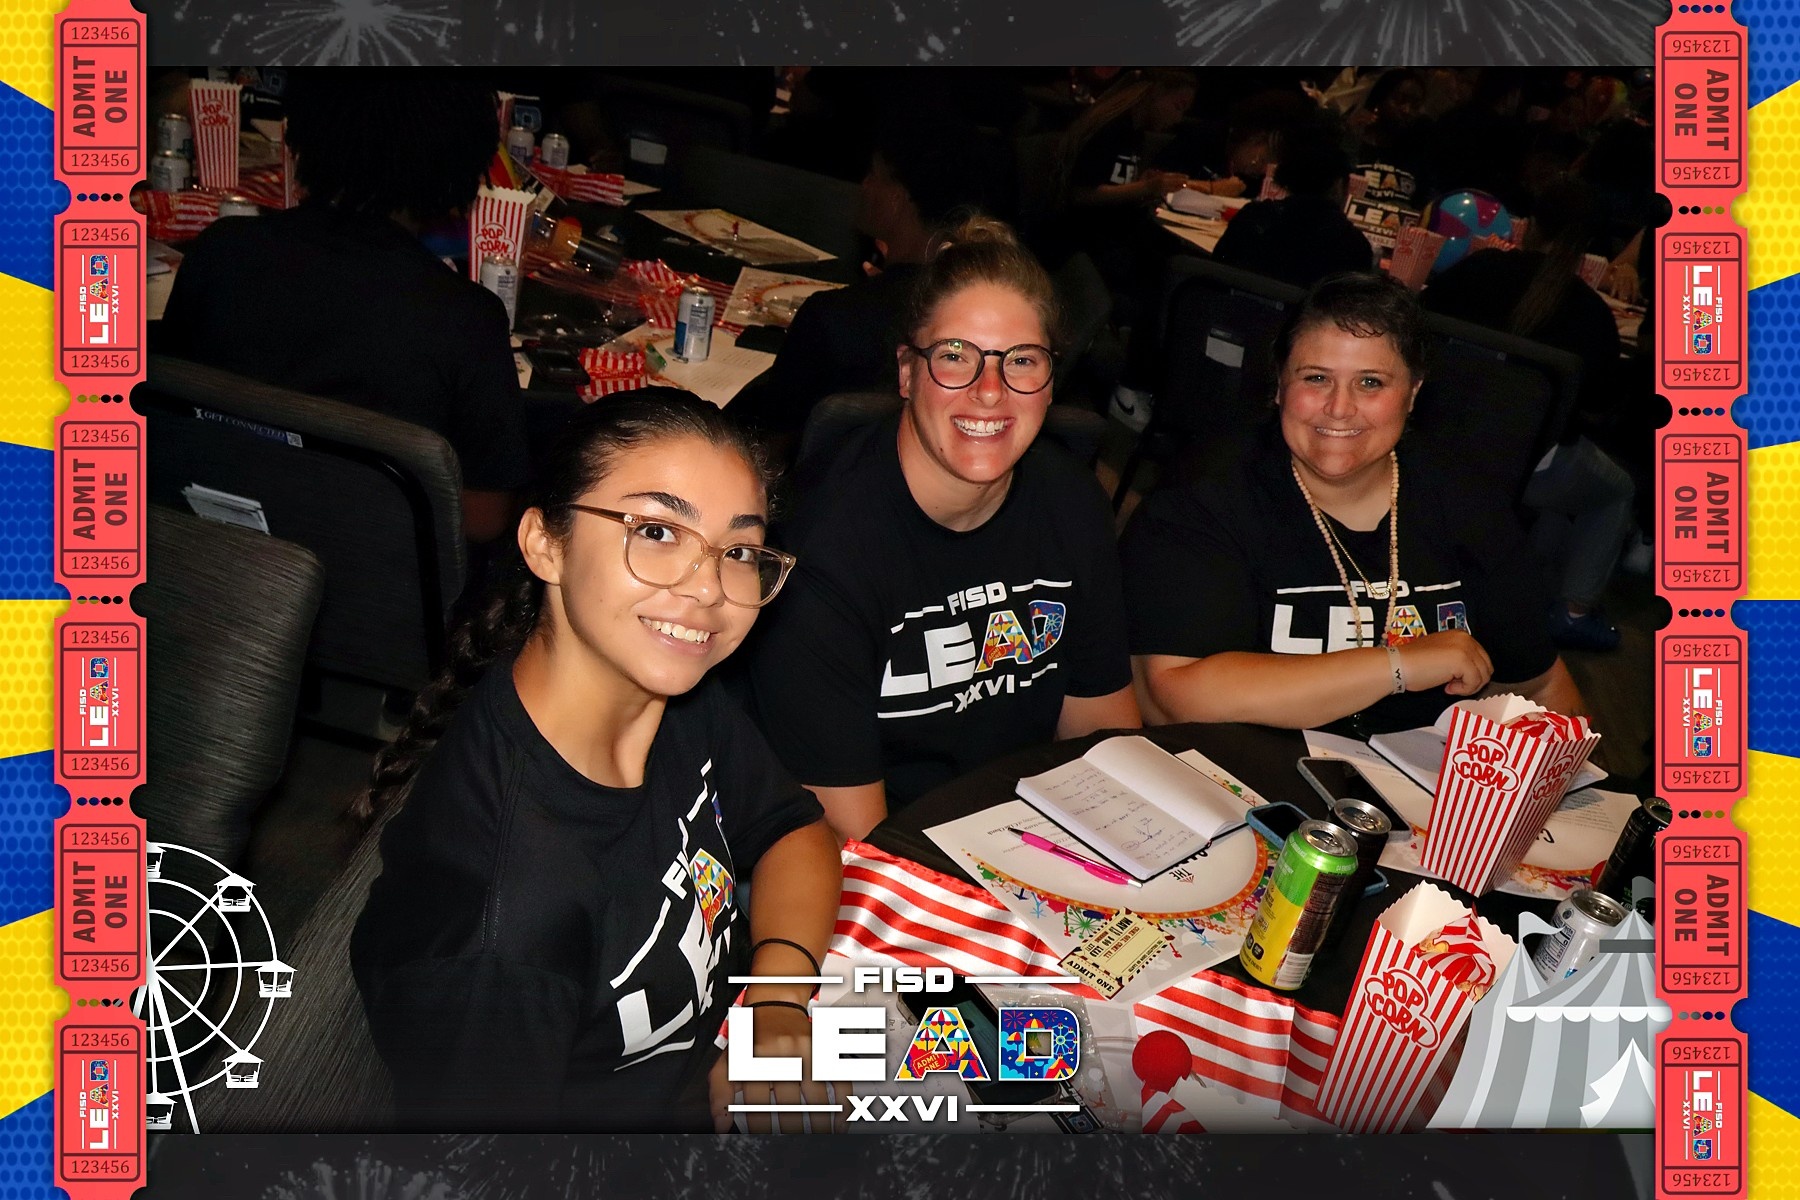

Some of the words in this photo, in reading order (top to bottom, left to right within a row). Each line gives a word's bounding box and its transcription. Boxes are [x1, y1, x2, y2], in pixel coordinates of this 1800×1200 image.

[202, 104, 222, 114] POP
[202, 116, 229, 126] CORN
[481, 228, 502, 240] POP
[480, 240, 509, 254] CORN
[204, 411, 224, 422] GET
[226, 416, 286, 438] CONNECTED
[947, 582, 1007, 616] FISD
[1350, 580, 1410, 600] FISD
[1271, 600, 1471, 655] LEAD
[880, 600, 1066, 697] LEAD
[954, 674, 1015, 714] XXVI
[1467, 743, 1504, 765] POP
[1460, 762, 1510, 790] CORN
[1546, 762, 1569, 782] POP
[1538, 777, 1564, 798] CORN
[1169, 868, 1192, 880] THE
[1116, 916, 1133, 932] MAY
[1089, 945, 1104, 958] LEAD
[1103, 950, 1114, 959] ALL
[1066, 960, 1096, 980] ADMIT
[1096, 978, 1114, 992] ONE
[1383, 972, 1424, 1009] POP
[1370, 994, 1427, 1043] CORN
